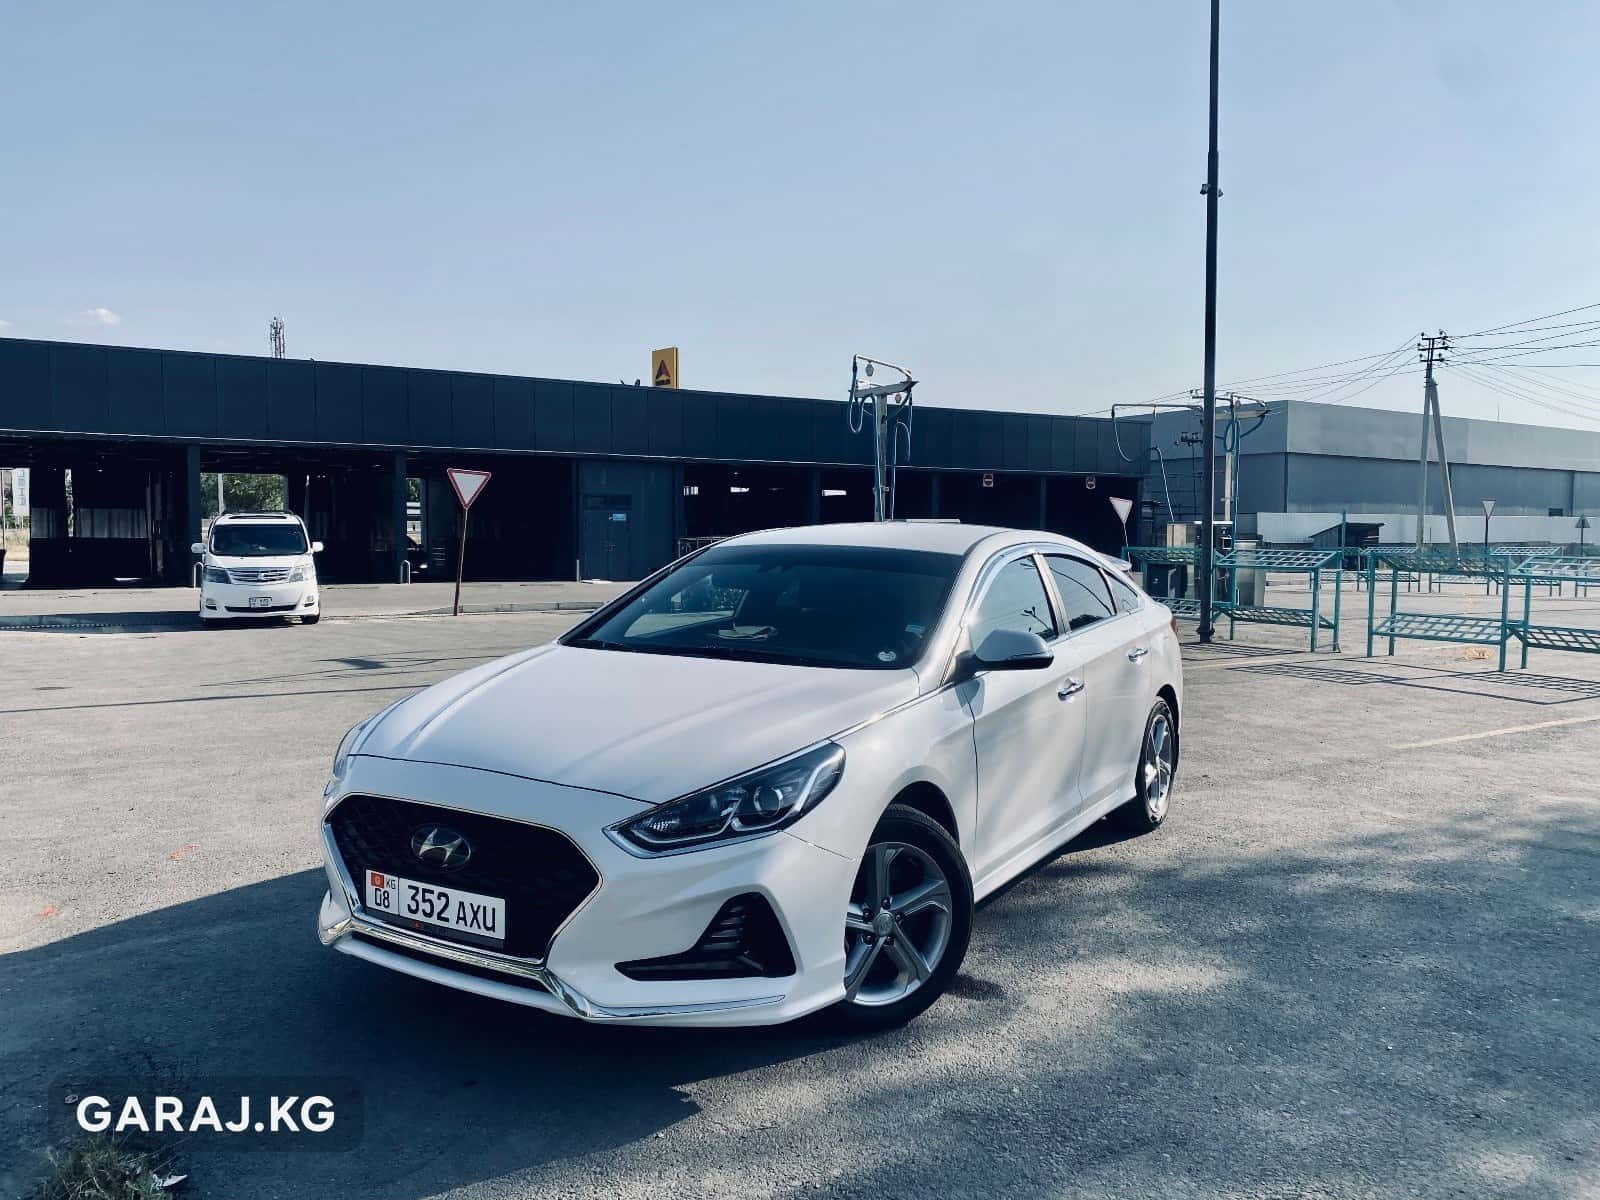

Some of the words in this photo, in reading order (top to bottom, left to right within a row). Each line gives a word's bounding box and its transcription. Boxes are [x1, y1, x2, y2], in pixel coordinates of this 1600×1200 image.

[386, 877, 396, 890] KG
[375, 888, 390, 909] 08
[407, 884, 450, 923] 352
[456, 900, 496, 933] AXU
